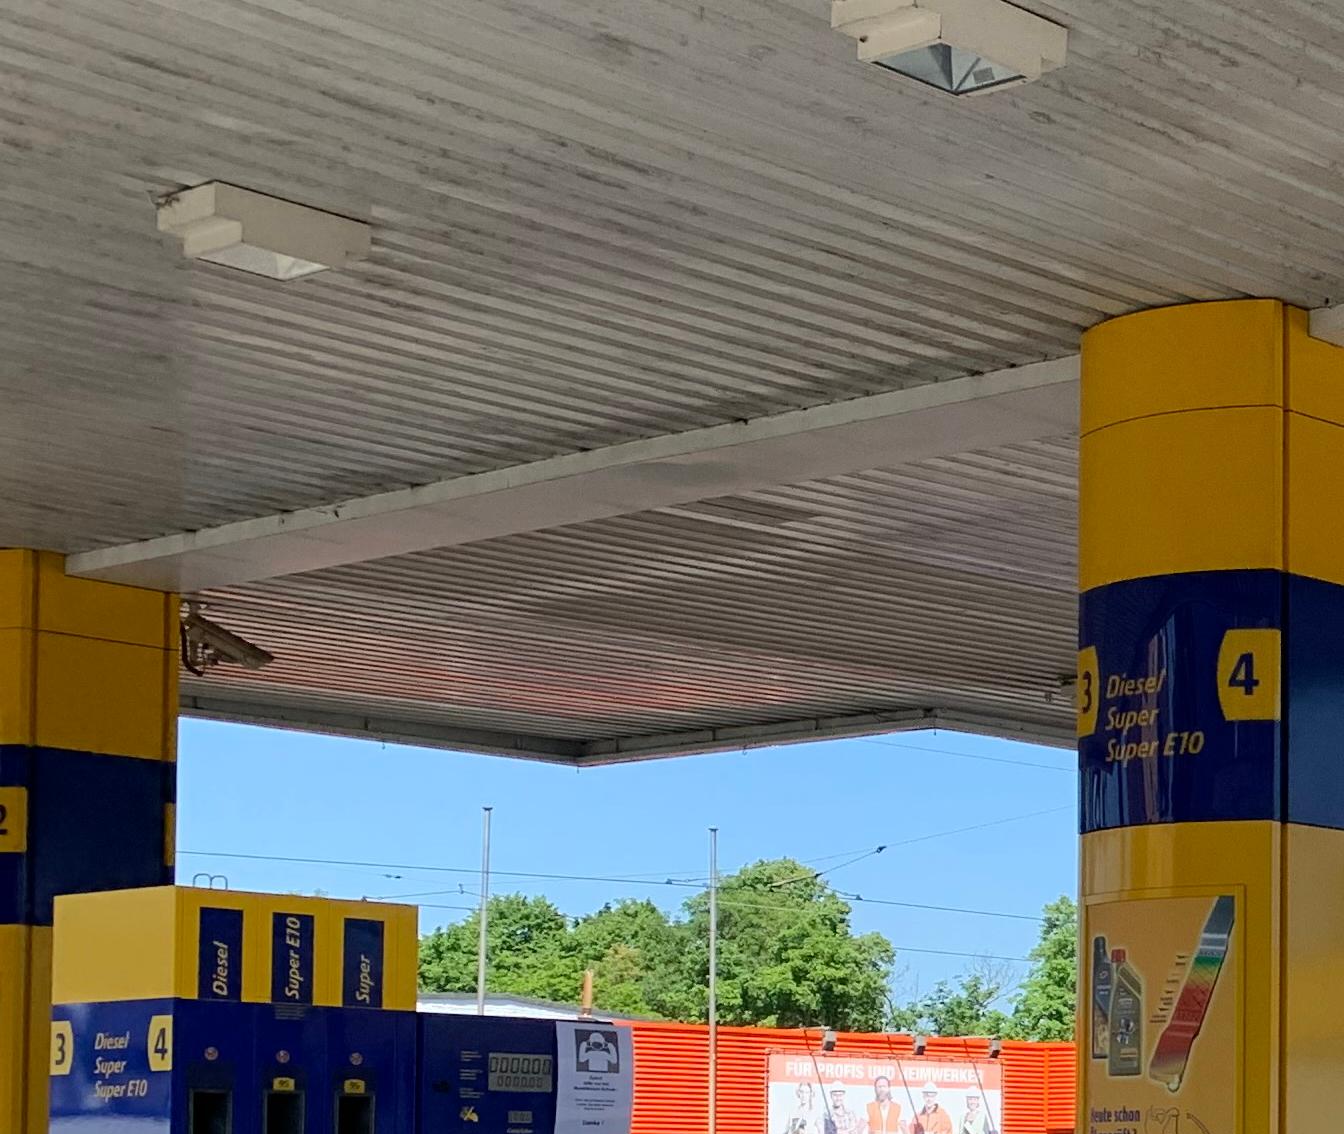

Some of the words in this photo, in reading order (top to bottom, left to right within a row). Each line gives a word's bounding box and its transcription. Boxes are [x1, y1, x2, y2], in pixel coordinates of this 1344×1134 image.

[1105, 668, 1167, 699] Diesel
[1228, 652, 1260, 696] 4
[1082, 671, 1092, 714] 3
[1105, 705, 1160, 735] Super
[1105, 738, 1160, 768] Super
[1163, 731, 1205, 757] E10
[285, 915, 300, 948] E10
[212, 940, 229, 996] Diesel
[285, 951, 304, 999] Super
[355, 954, 376, 1005] Super
[54, 1032, 66, 1066] 3
[94, 1030, 130, 1051] Diesel
[154, 1027, 168, 1061] 4
[94, 1056, 126, 1076] Super
[785, 1061, 813, 1077] FÜR
[817, 1063, 864, 1079] PROFIS
[868, 1065, 895, 1081] UND
[900, 1066, 985, 1084] HEIMWERKER
[94, 1083, 126, 1103] Super
[127, 1080, 148, 1098] E10
[1091, 1107, 1112, 1123] Heute
[1114, 1106, 1141, 1122] schon
